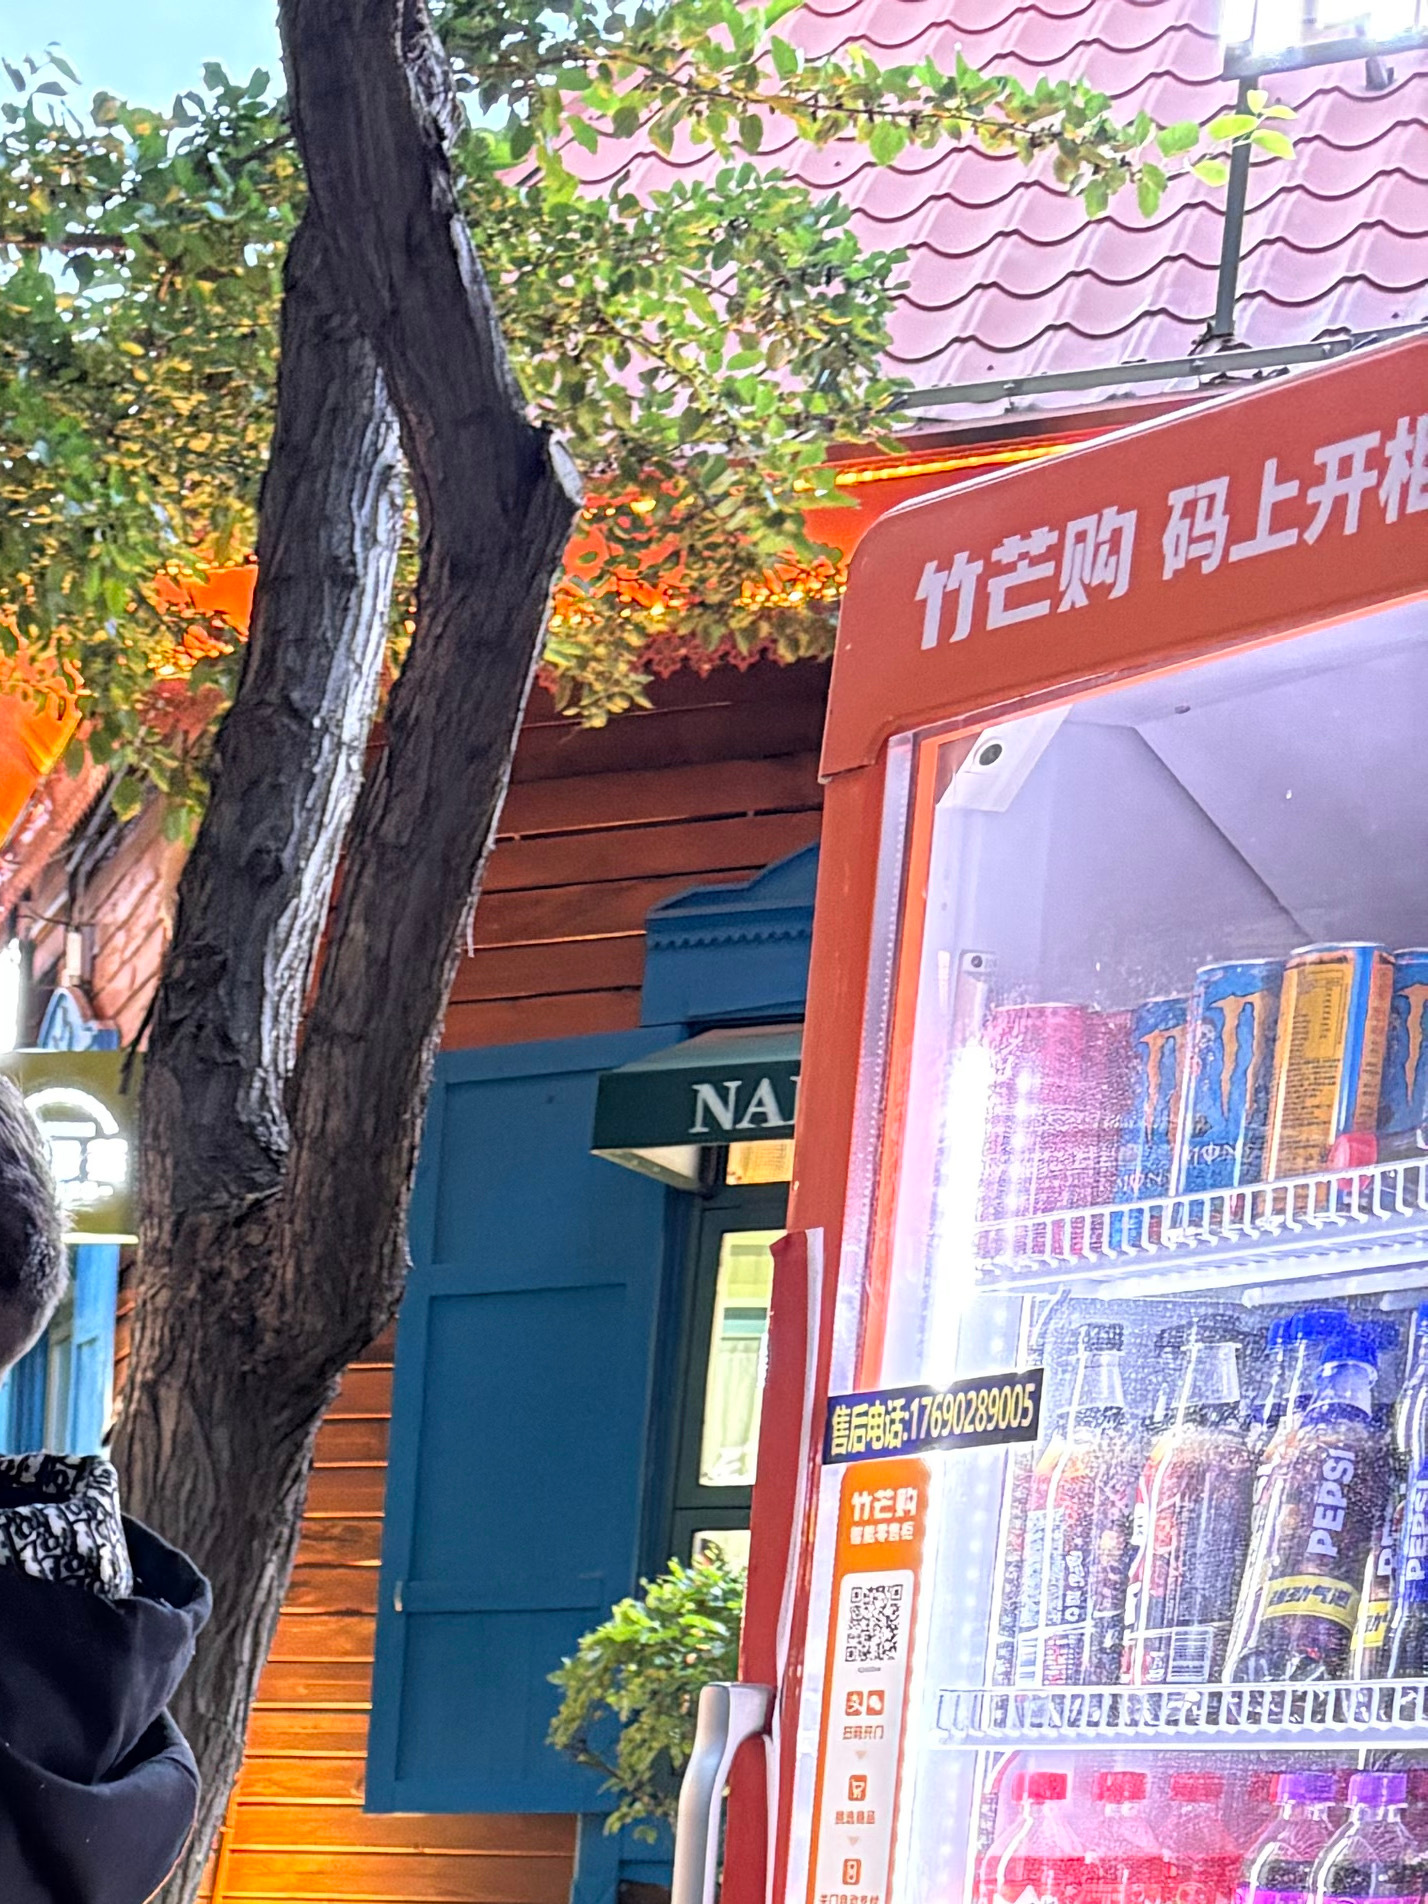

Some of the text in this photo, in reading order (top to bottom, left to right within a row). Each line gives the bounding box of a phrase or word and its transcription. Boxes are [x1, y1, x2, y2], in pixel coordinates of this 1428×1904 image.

[915, 505, 1138, 650] 竹芒购
[688, 1075, 800, 1133] NA
[851, 1487, 918, 1522] 竹芒购
[1306, 1447, 1356, 1557] PEPSI
